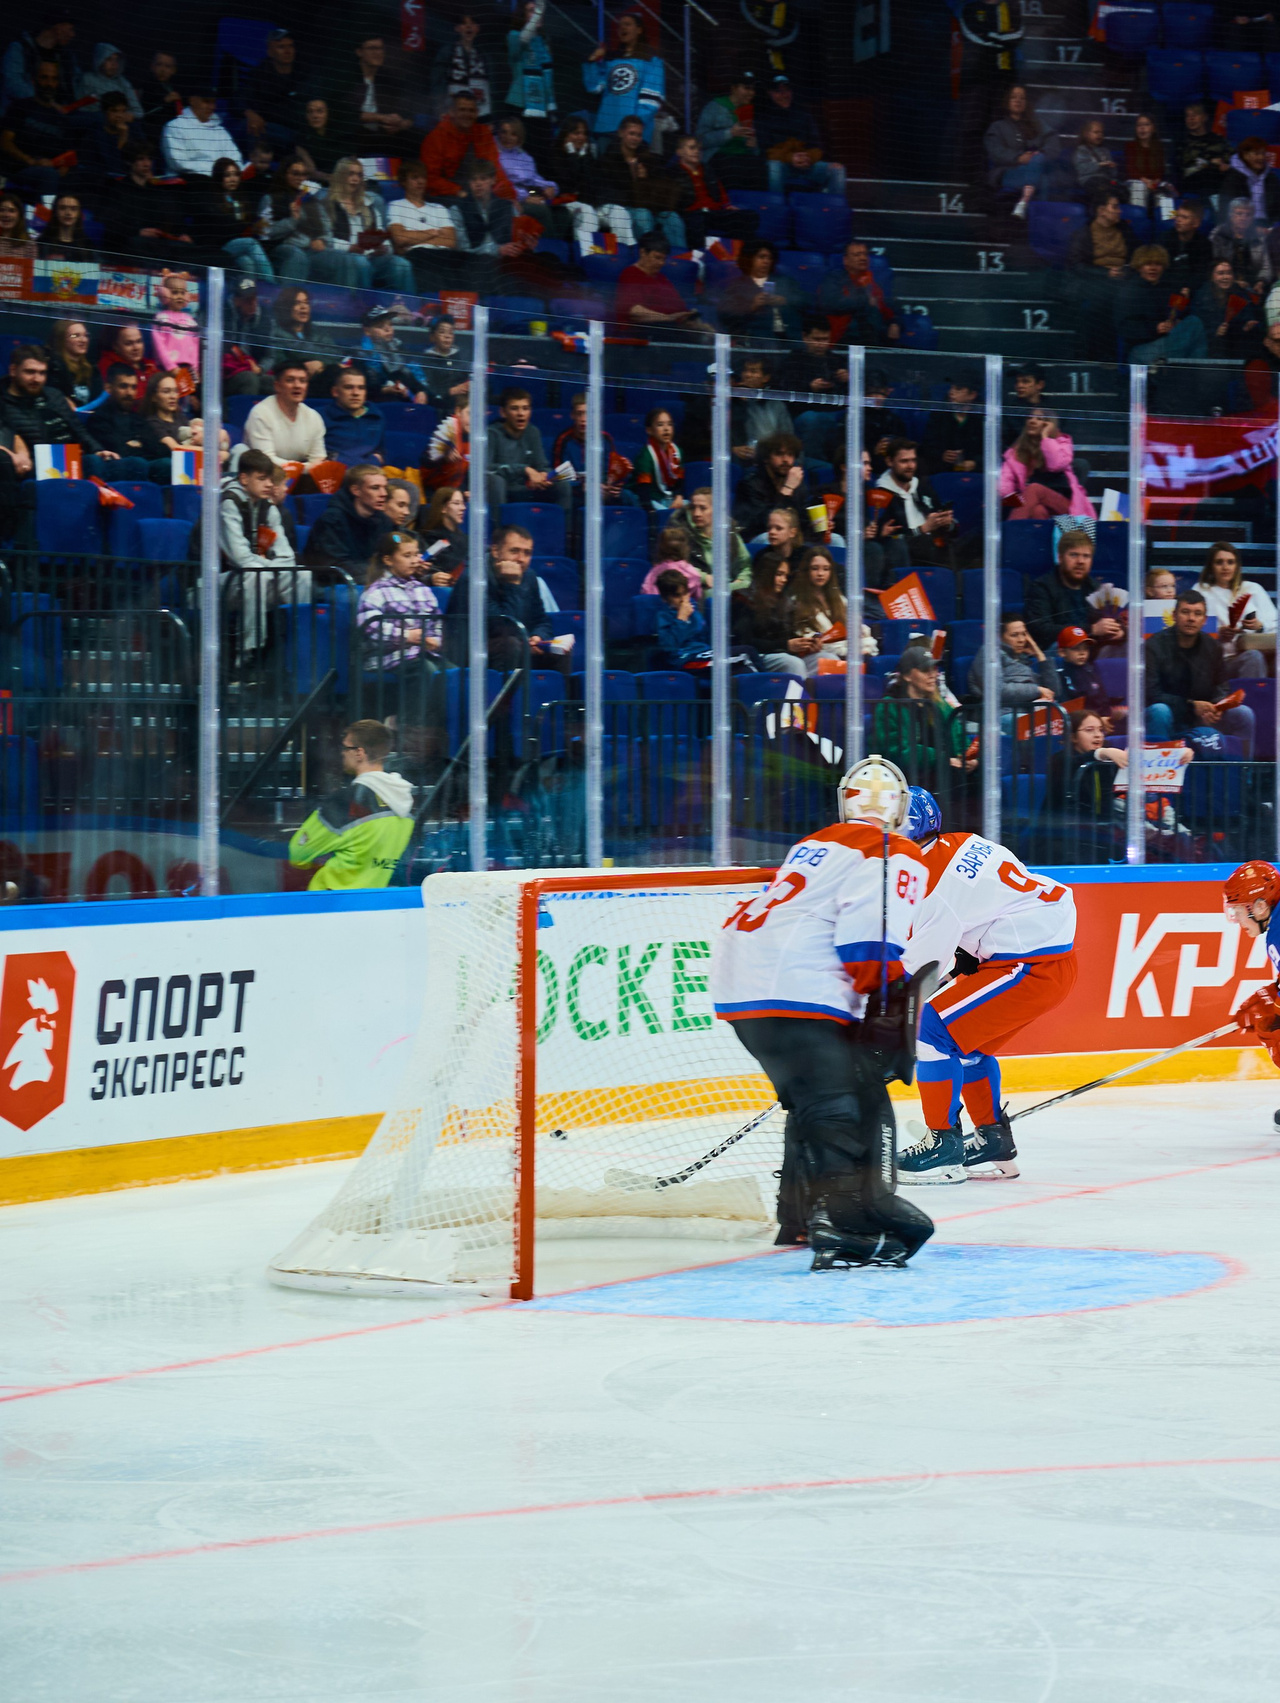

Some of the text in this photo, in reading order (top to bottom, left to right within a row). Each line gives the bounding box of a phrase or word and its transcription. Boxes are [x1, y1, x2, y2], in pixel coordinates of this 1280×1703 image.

[1056, 45, 1083, 63] 17
[1101, 98, 1126, 114] 16
[938, 193, 965, 214] 14
[976, 251, 1006, 272] 13
[1022, 309, 1050, 331] 12
[1069, 372, 1092, 391] 11
[97, 970, 255, 1045] СПОРТ
[91, 1046, 245, 1100] ЭКСПРЕСС
